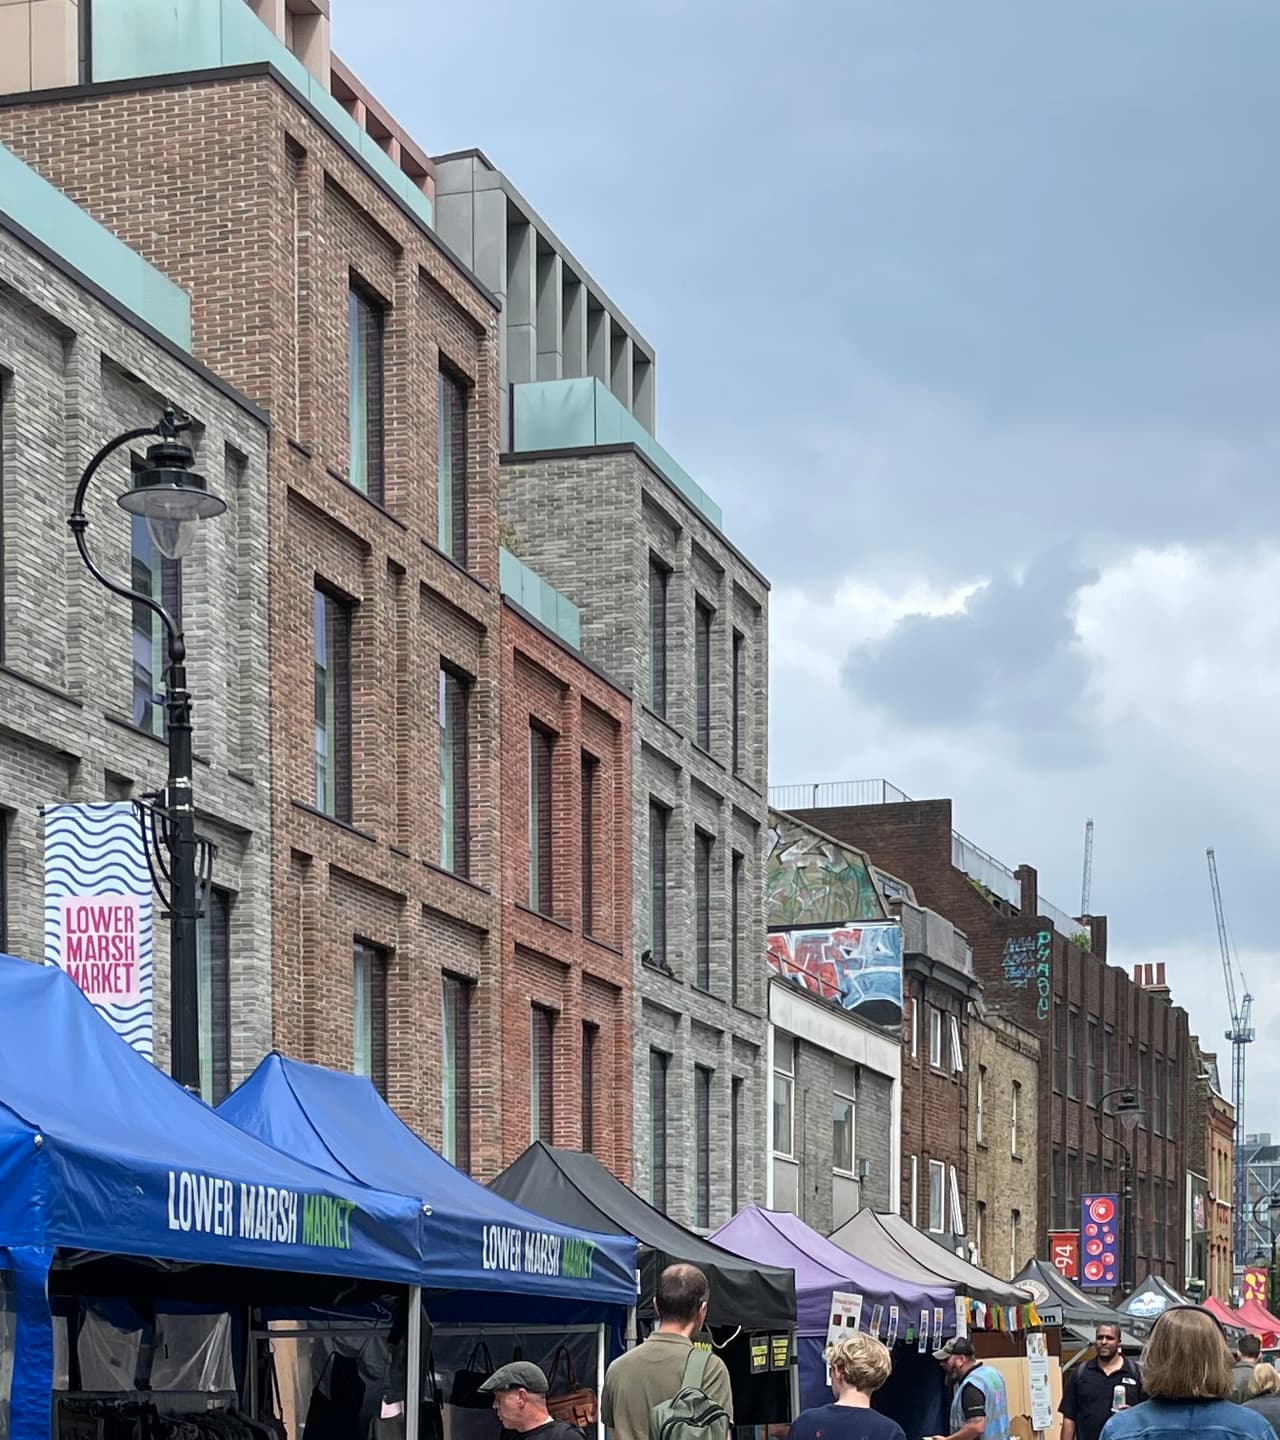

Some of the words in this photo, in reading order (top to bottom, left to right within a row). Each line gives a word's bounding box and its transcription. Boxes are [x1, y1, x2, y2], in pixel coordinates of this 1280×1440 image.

[66, 905, 135, 934] LOWER
[66, 934, 135, 962] MARSH
[66, 962, 135, 994] MARKET
[168, 1170, 234, 1237] LOWER
[239, 1182, 298, 1244] MARSH
[302, 1193, 356, 1250] MARKET
[482, 1224, 522, 1272] LOWER
[524, 1231, 561, 1276] MARSH
[561, 1236, 596, 1279] MARKET
